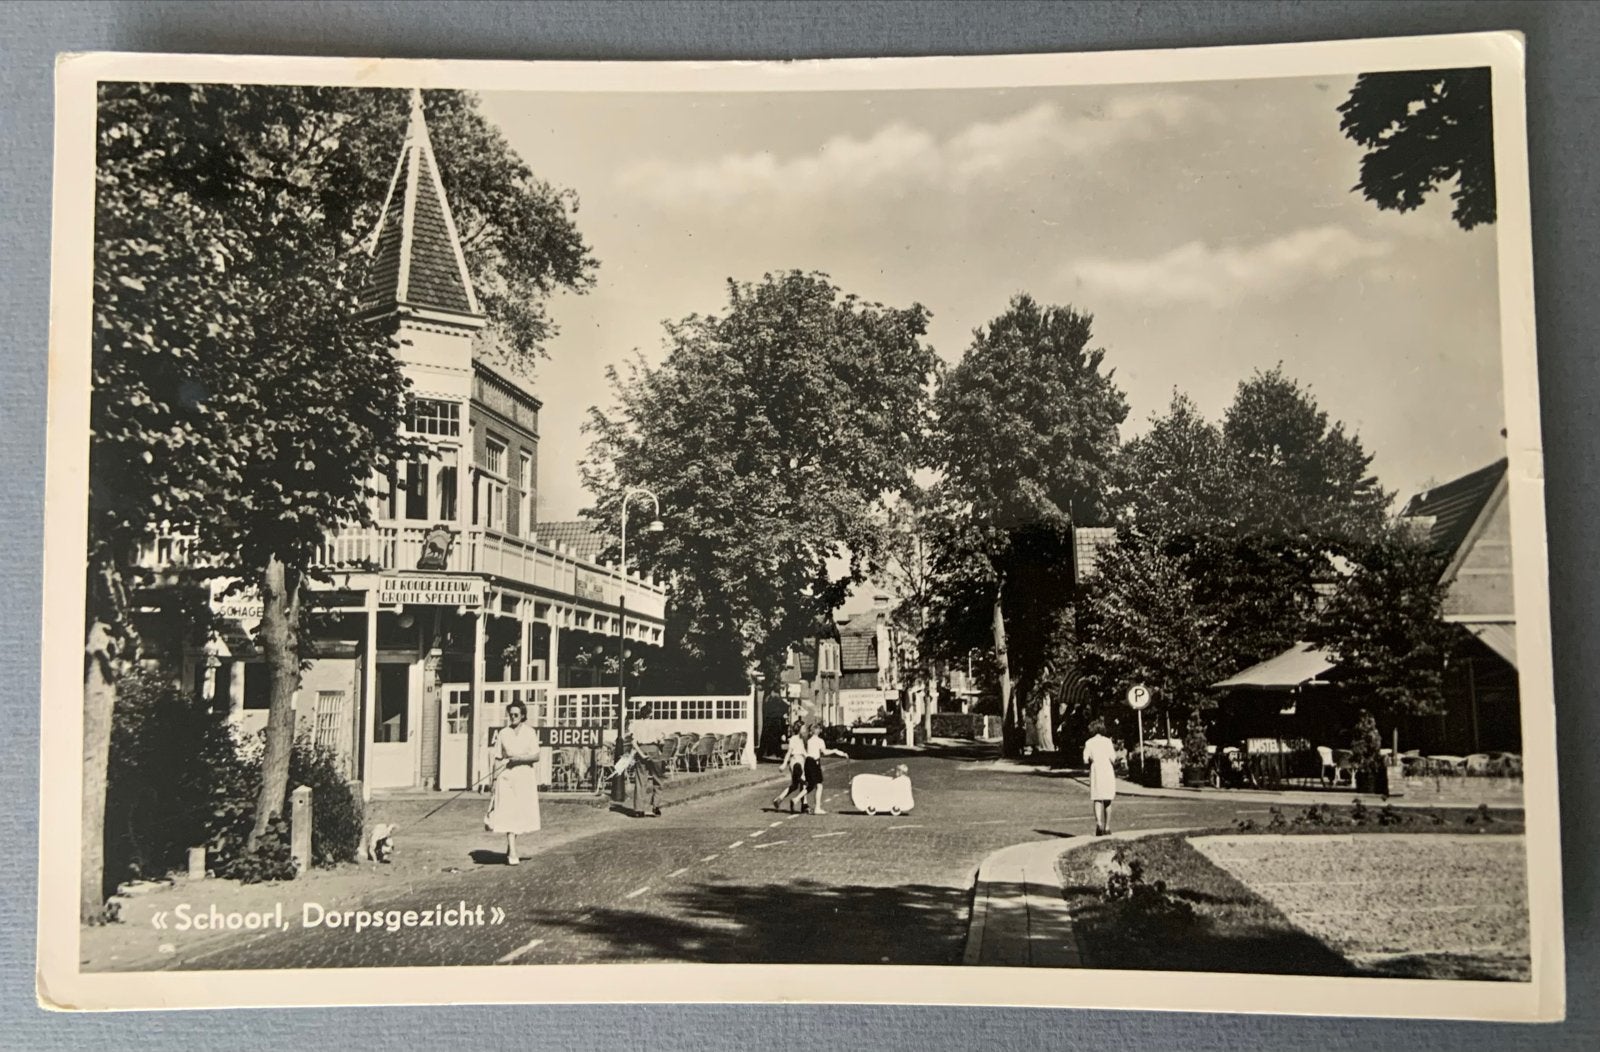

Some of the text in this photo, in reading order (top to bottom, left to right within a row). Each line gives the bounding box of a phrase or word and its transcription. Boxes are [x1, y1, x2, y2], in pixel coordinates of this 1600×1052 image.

[385, 580, 472, 592] DE ROODE LEEUW
[381, 592, 479, 604] GROOTE SPEELTUIN
[220, 605, 264, 618] SCHAGE
[1135, 688, 1145, 702] P
[549, 729, 600, 745] BIEREN
